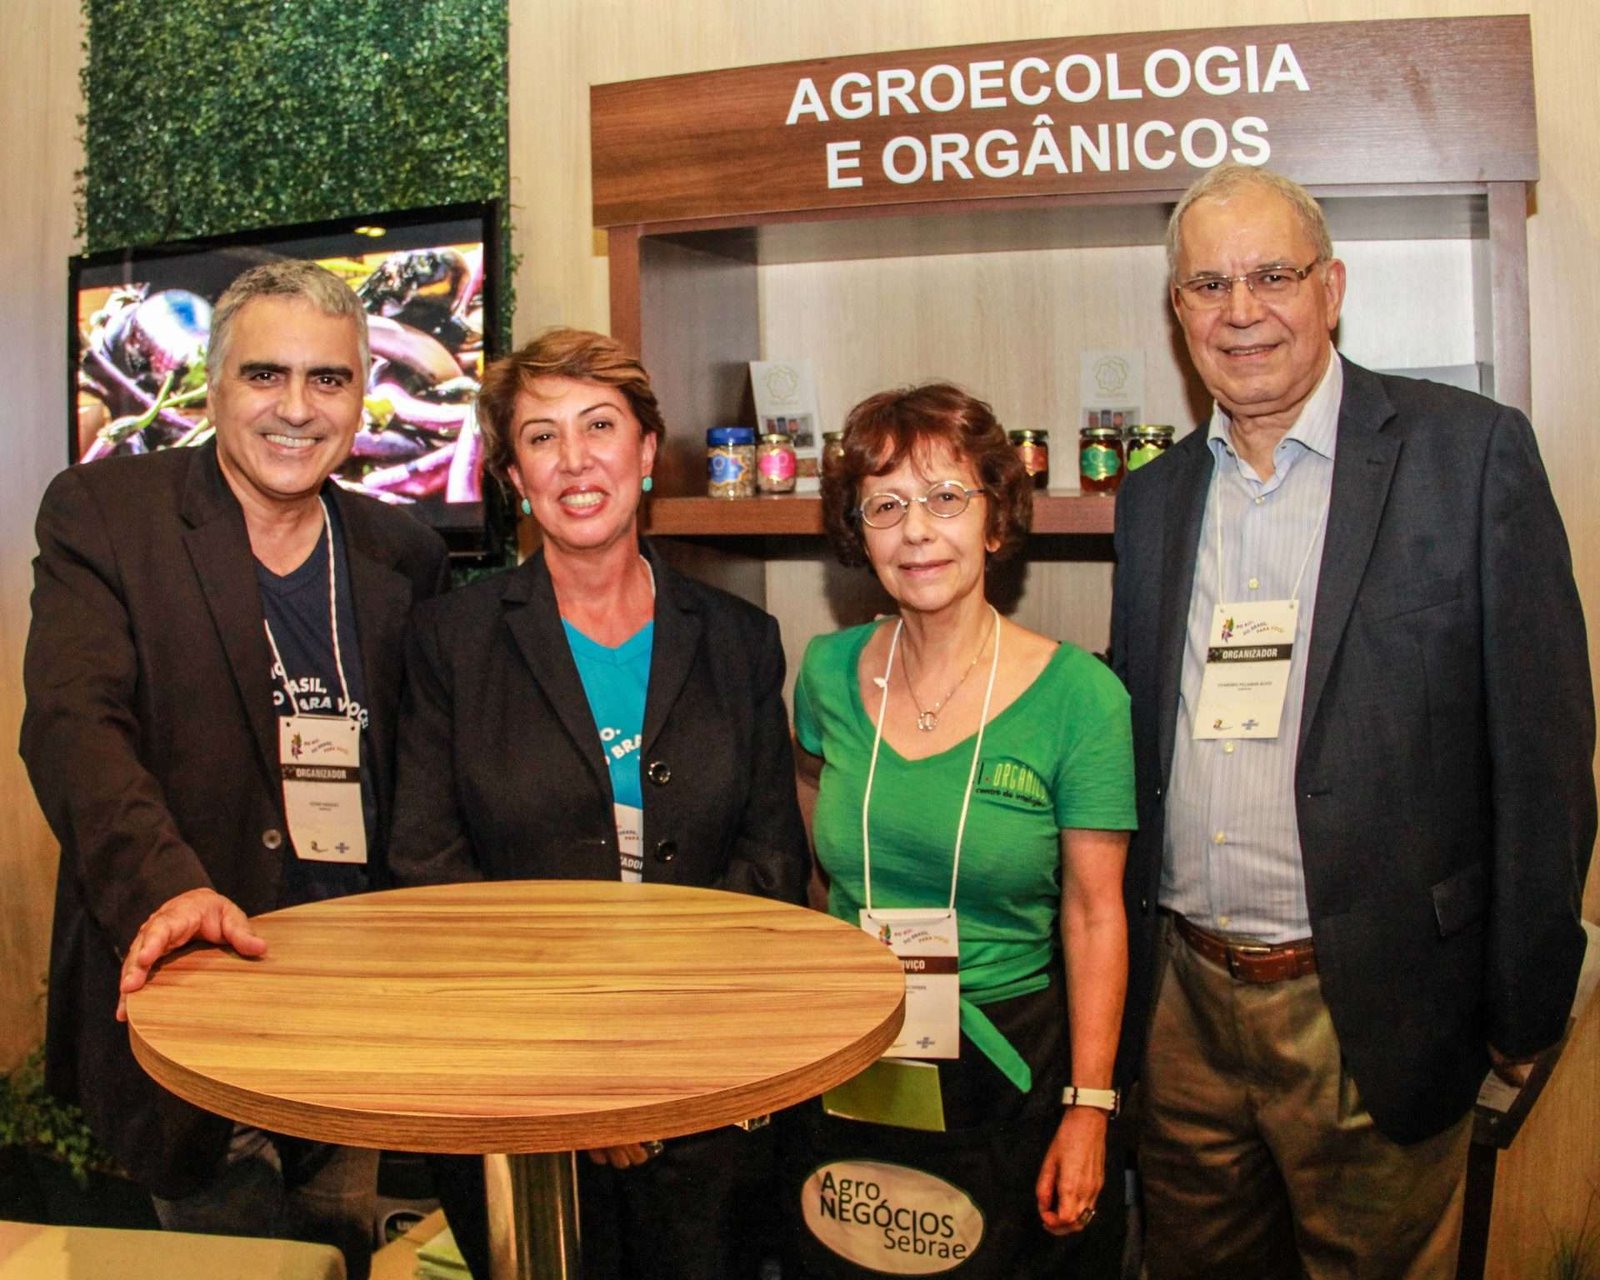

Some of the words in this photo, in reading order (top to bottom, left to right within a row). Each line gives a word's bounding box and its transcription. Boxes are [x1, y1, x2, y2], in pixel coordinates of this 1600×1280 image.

[784, 43, 1310, 125] AGROECOLOGIA
[825, 140, 864, 189] E
[881, 113, 1272, 184] ORGÂNICOS
[1222, 648, 1278, 660] ORGANIZADOR
[296, 767, 347, 780] ORGANIZADOR
[904, 959, 925, 971] VIÇO
[820, 1170, 881, 1203] Agro
[819, 1194, 955, 1239] NEGÓCIOS
[883, 1227, 967, 1260] Sebrae
